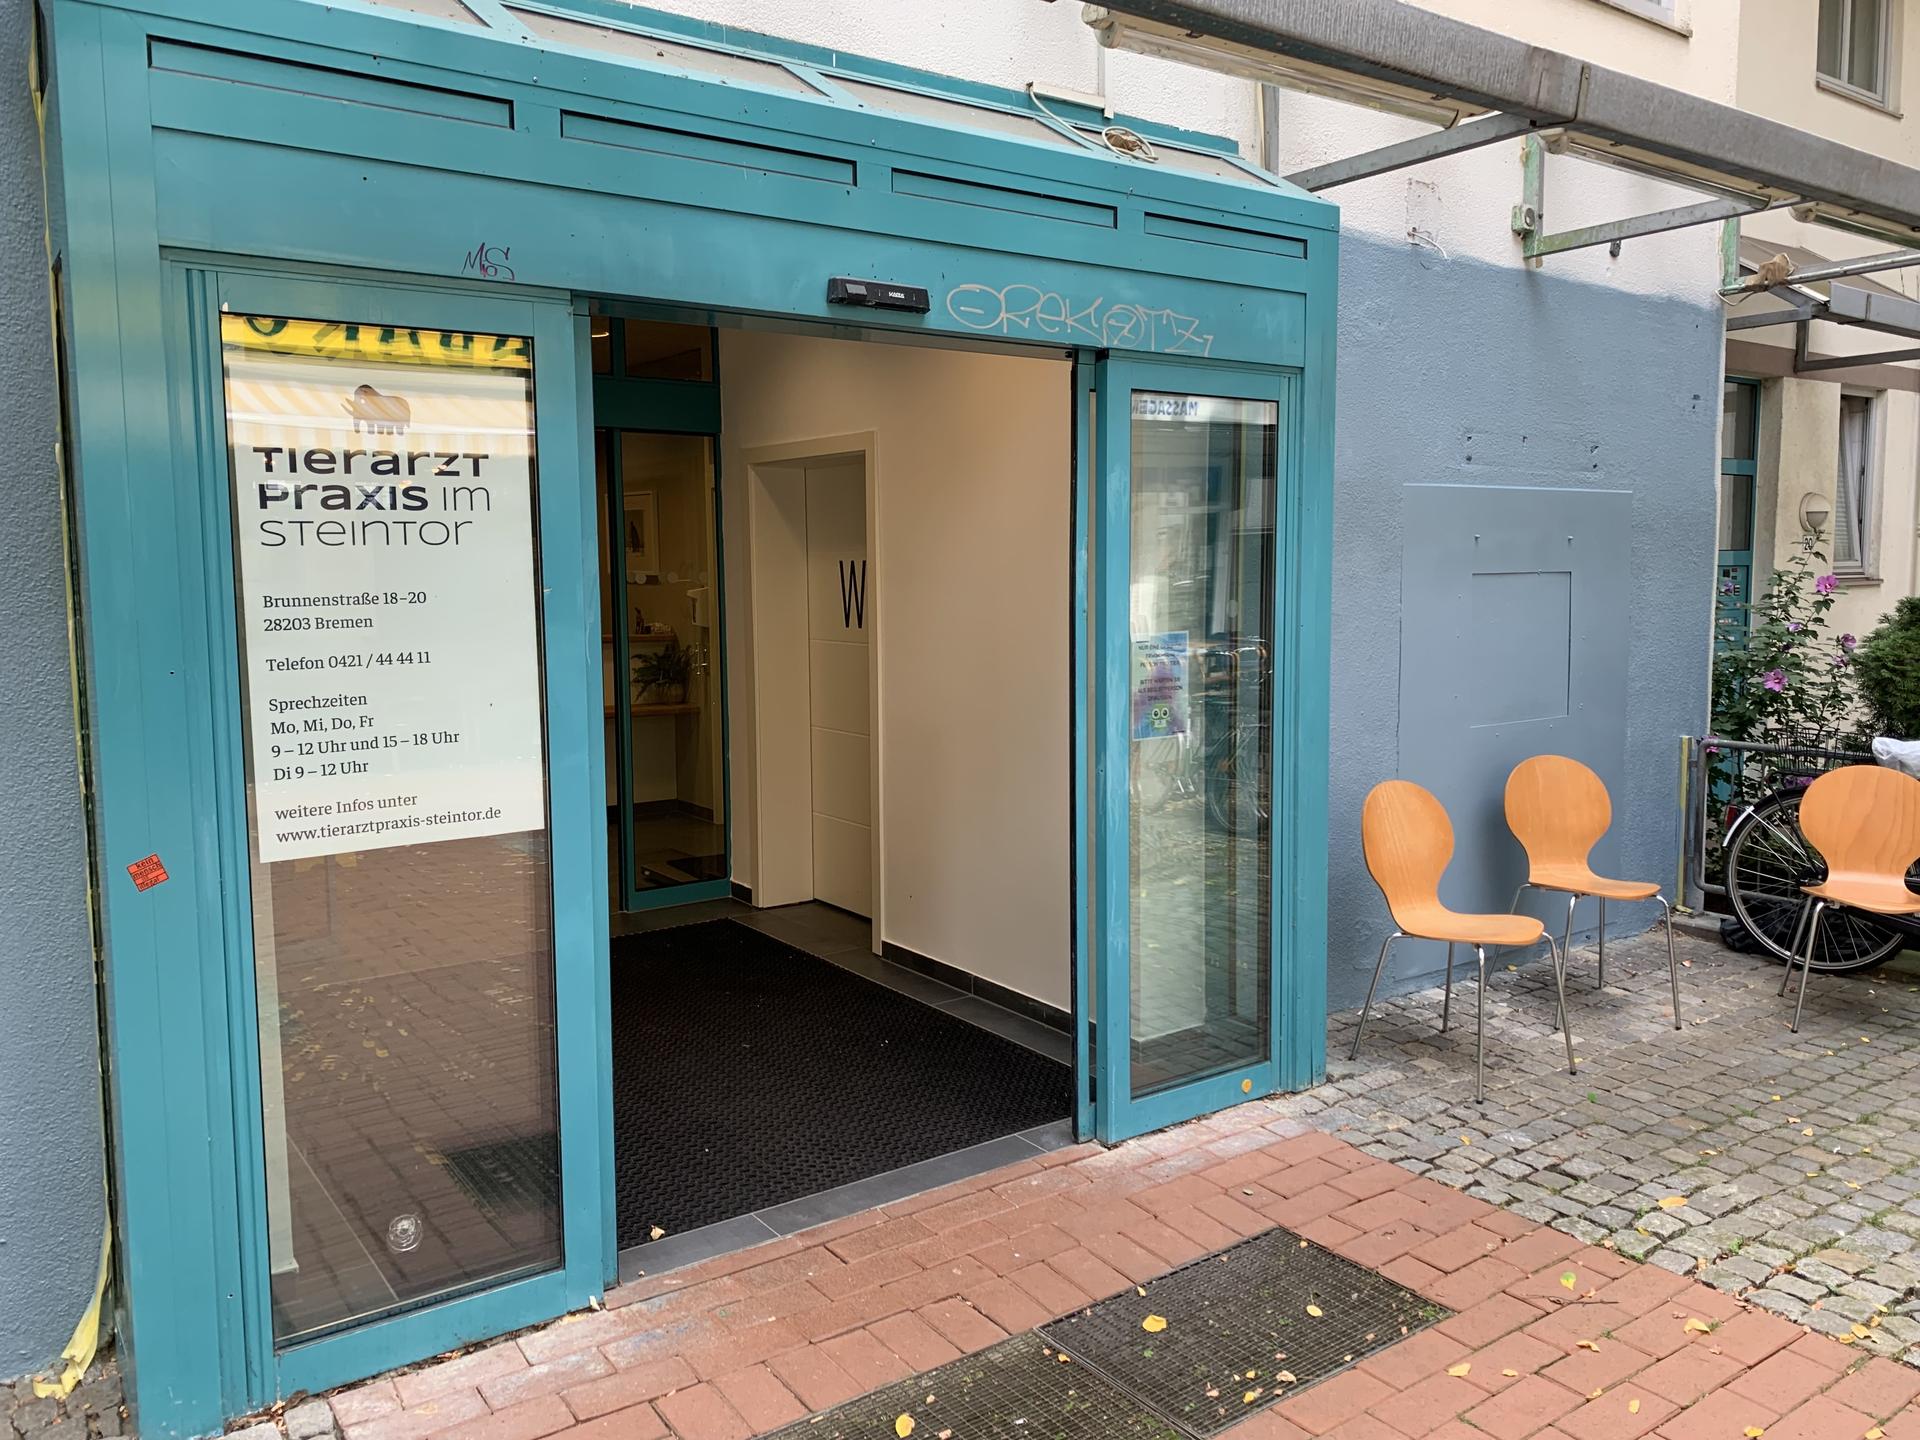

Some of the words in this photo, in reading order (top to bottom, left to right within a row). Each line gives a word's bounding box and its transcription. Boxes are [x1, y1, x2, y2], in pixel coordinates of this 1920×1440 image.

[262, 591, 380, 609] Brunnenstraße
[839, 559, 867, 629] W
[263, 617, 312, 632] 28203
[314, 616, 374, 630] Bremen
[265, 656, 325, 672] Telefon
[328, 654, 364, 669] 0421
[268, 693, 368, 713] Sprechzeiten
[270, 721, 300, 736] Mo,
[302, 717, 328, 733] Mi,
[331, 717, 356, 732] Do,
[358, 715, 375, 728] Fr
[317, 739, 348, 754] Uhr
[350, 735, 380, 751] und
[431, 730, 460, 745] Uhr
[272, 766, 293, 782] Di
[340, 760, 369, 775] Uhr
[274, 804, 333, 821] weitere
[336, 798, 374, 814] Infos
[377, 795, 418, 809] unter
[275, 807, 502, 843] www.tierarztpraxis-steintor.de
